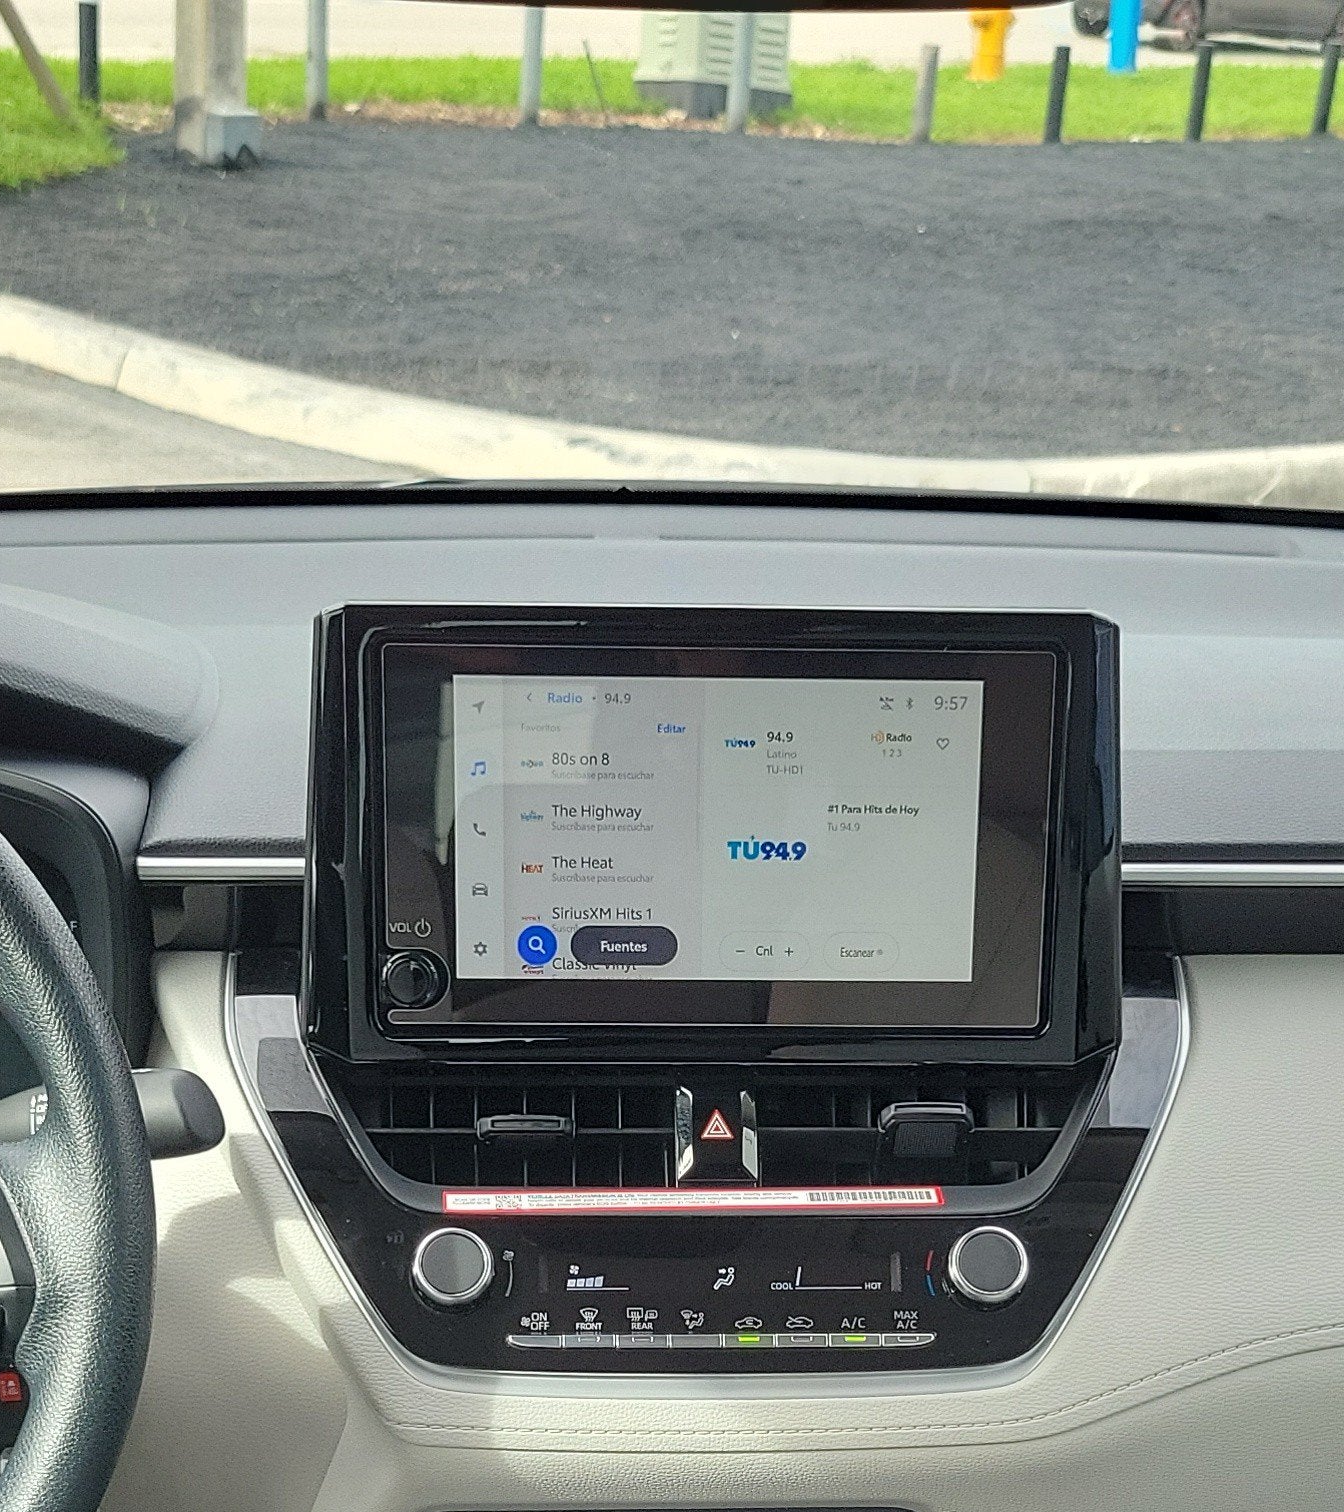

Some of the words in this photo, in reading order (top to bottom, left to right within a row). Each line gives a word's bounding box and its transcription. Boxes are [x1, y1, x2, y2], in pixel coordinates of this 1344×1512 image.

[548, 693, 582, 703] Radio
[604, 693, 631, 704] 94.9
[934, 695, 968, 711] 9:57
[657, 723, 686, 733] Editar
[766, 731, 793, 743] 94.9
[886, 733, 912, 743] Radio
[552, 752, 576, 766] 80s
[580, 754, 597, 766] on
[601, 752, 610, 766] 8
[766, 749, 797, 759] Latino
[597, 772, 616, 781] para
[617, 771, 654, 780] escuchar
[551, 804, 577, 818] The
[581, 804, 642, 821] Highway
[827, 805, 839, 814] #1
[841, 805, 861, 814] Para
[864, 805, 883, 814] Hits
[885, 805, 897, 814] de
[899, 805, 919, 817] Hoy
[597, 824, 615, 833] para
[617, 823, 654, 832] escuchar
[840, 823, 860, 832] 94.9
[551, 856, 577, 869] The
[581, 856, 613, 869] Heat
[521, 863, 544, 874] HEAT
[597, 875, 615, 884] para
[617, 874, 654, 883] escuchar
[552, 907, 612, 920] SiriusXM
[616, 907, 642, 920] Hits
[646, 907, 653, 920] 1
[389, 922, 412, 933] VOL
[600, 940, 648, 953] Fuentes
[755, 945, 773, 956] Cnl
[840, 947, 874, 958] Escanear
[770, 1282, 793, 1290] COOL
[864, 1282, 882, 1290] HOT
[530, 1312, 547, 1321] ON
[893, 1311, 918, 1320] MAX
[530, 1321, 550, 1330] OFF
[575, 1322, 602, 1330] FRONT
[631, 1322, 653, 1330] REAR
[840, 1317, 866, 1329] A/C
[896, 1320, 917, 1329] A/C
